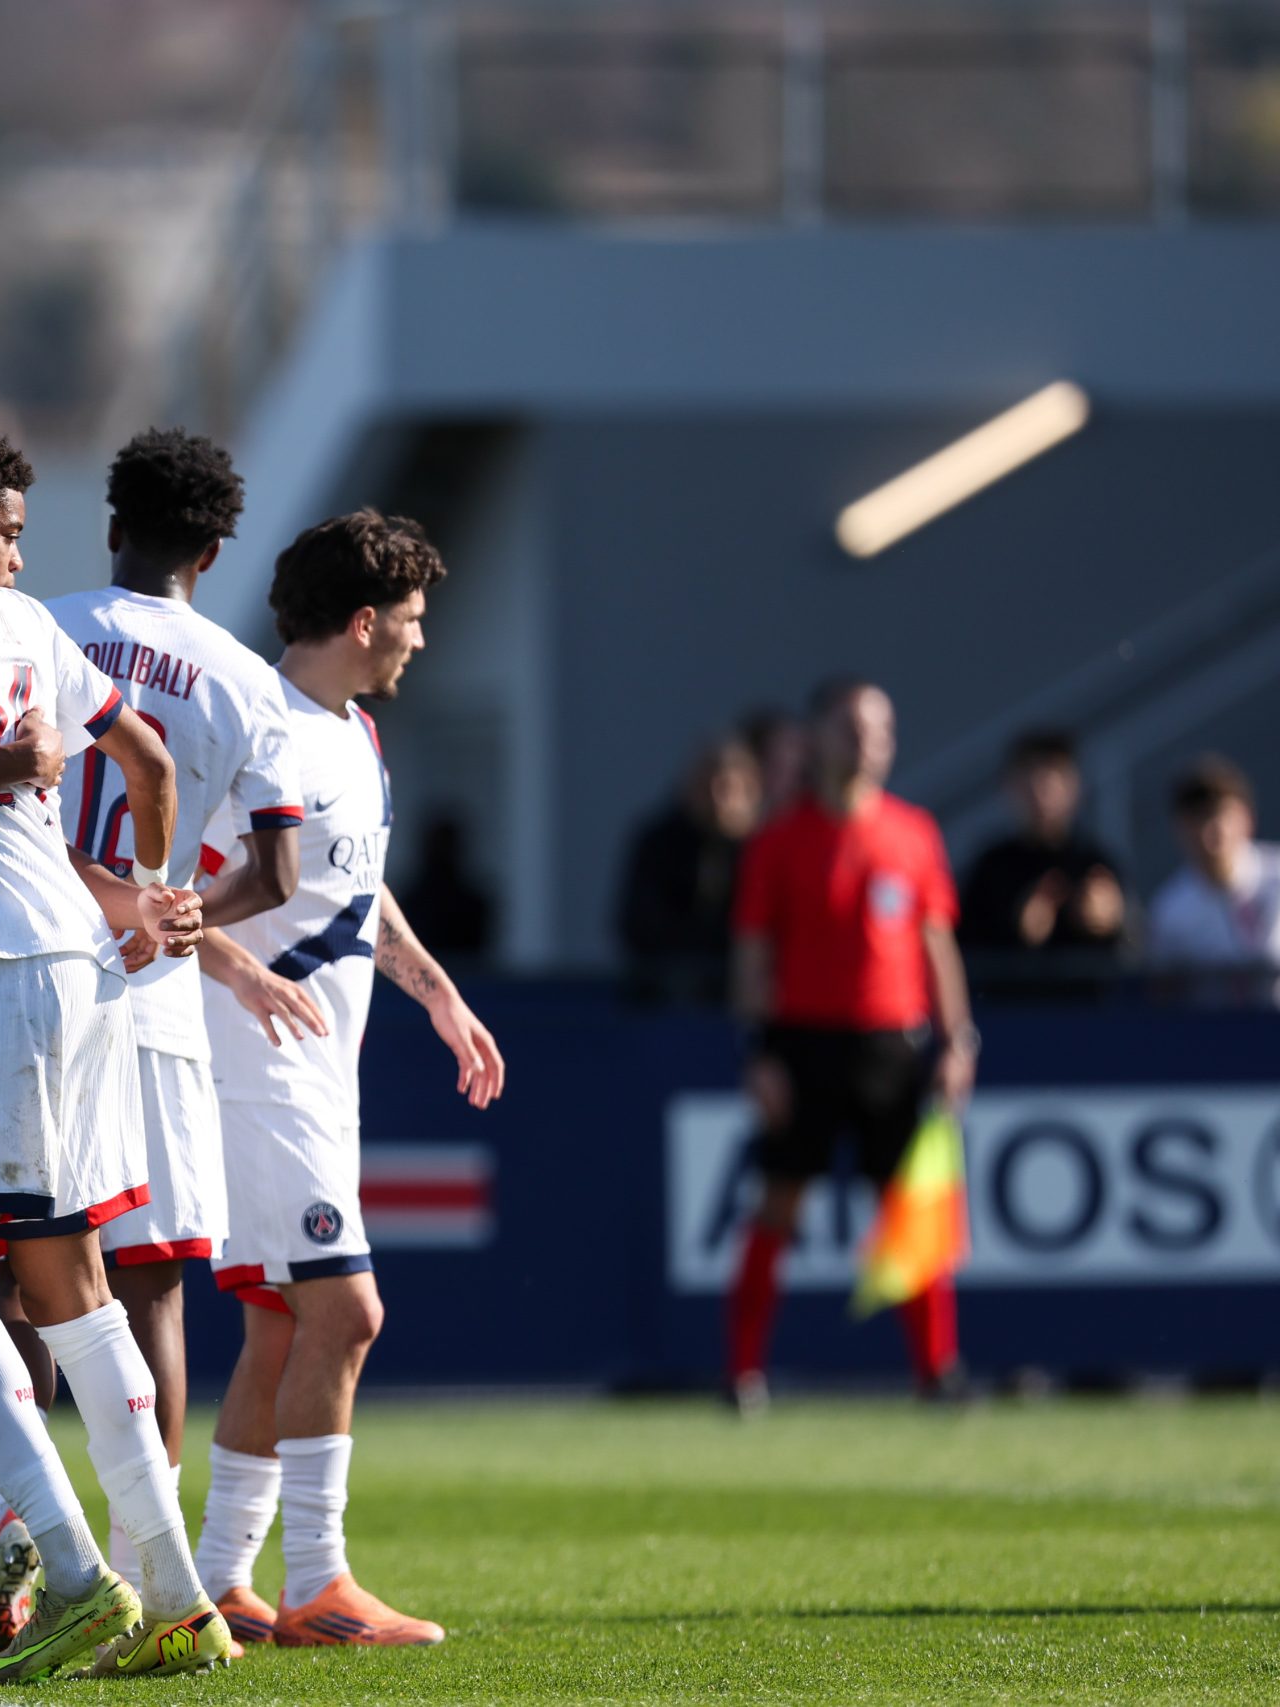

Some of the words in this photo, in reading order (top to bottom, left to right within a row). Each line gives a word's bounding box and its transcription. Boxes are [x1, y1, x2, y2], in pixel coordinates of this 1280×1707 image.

[77, 641, 202, 700] OULIBALY
[328, 832, 386, 875] QAT
[351, 870, 379, 890] AIR
